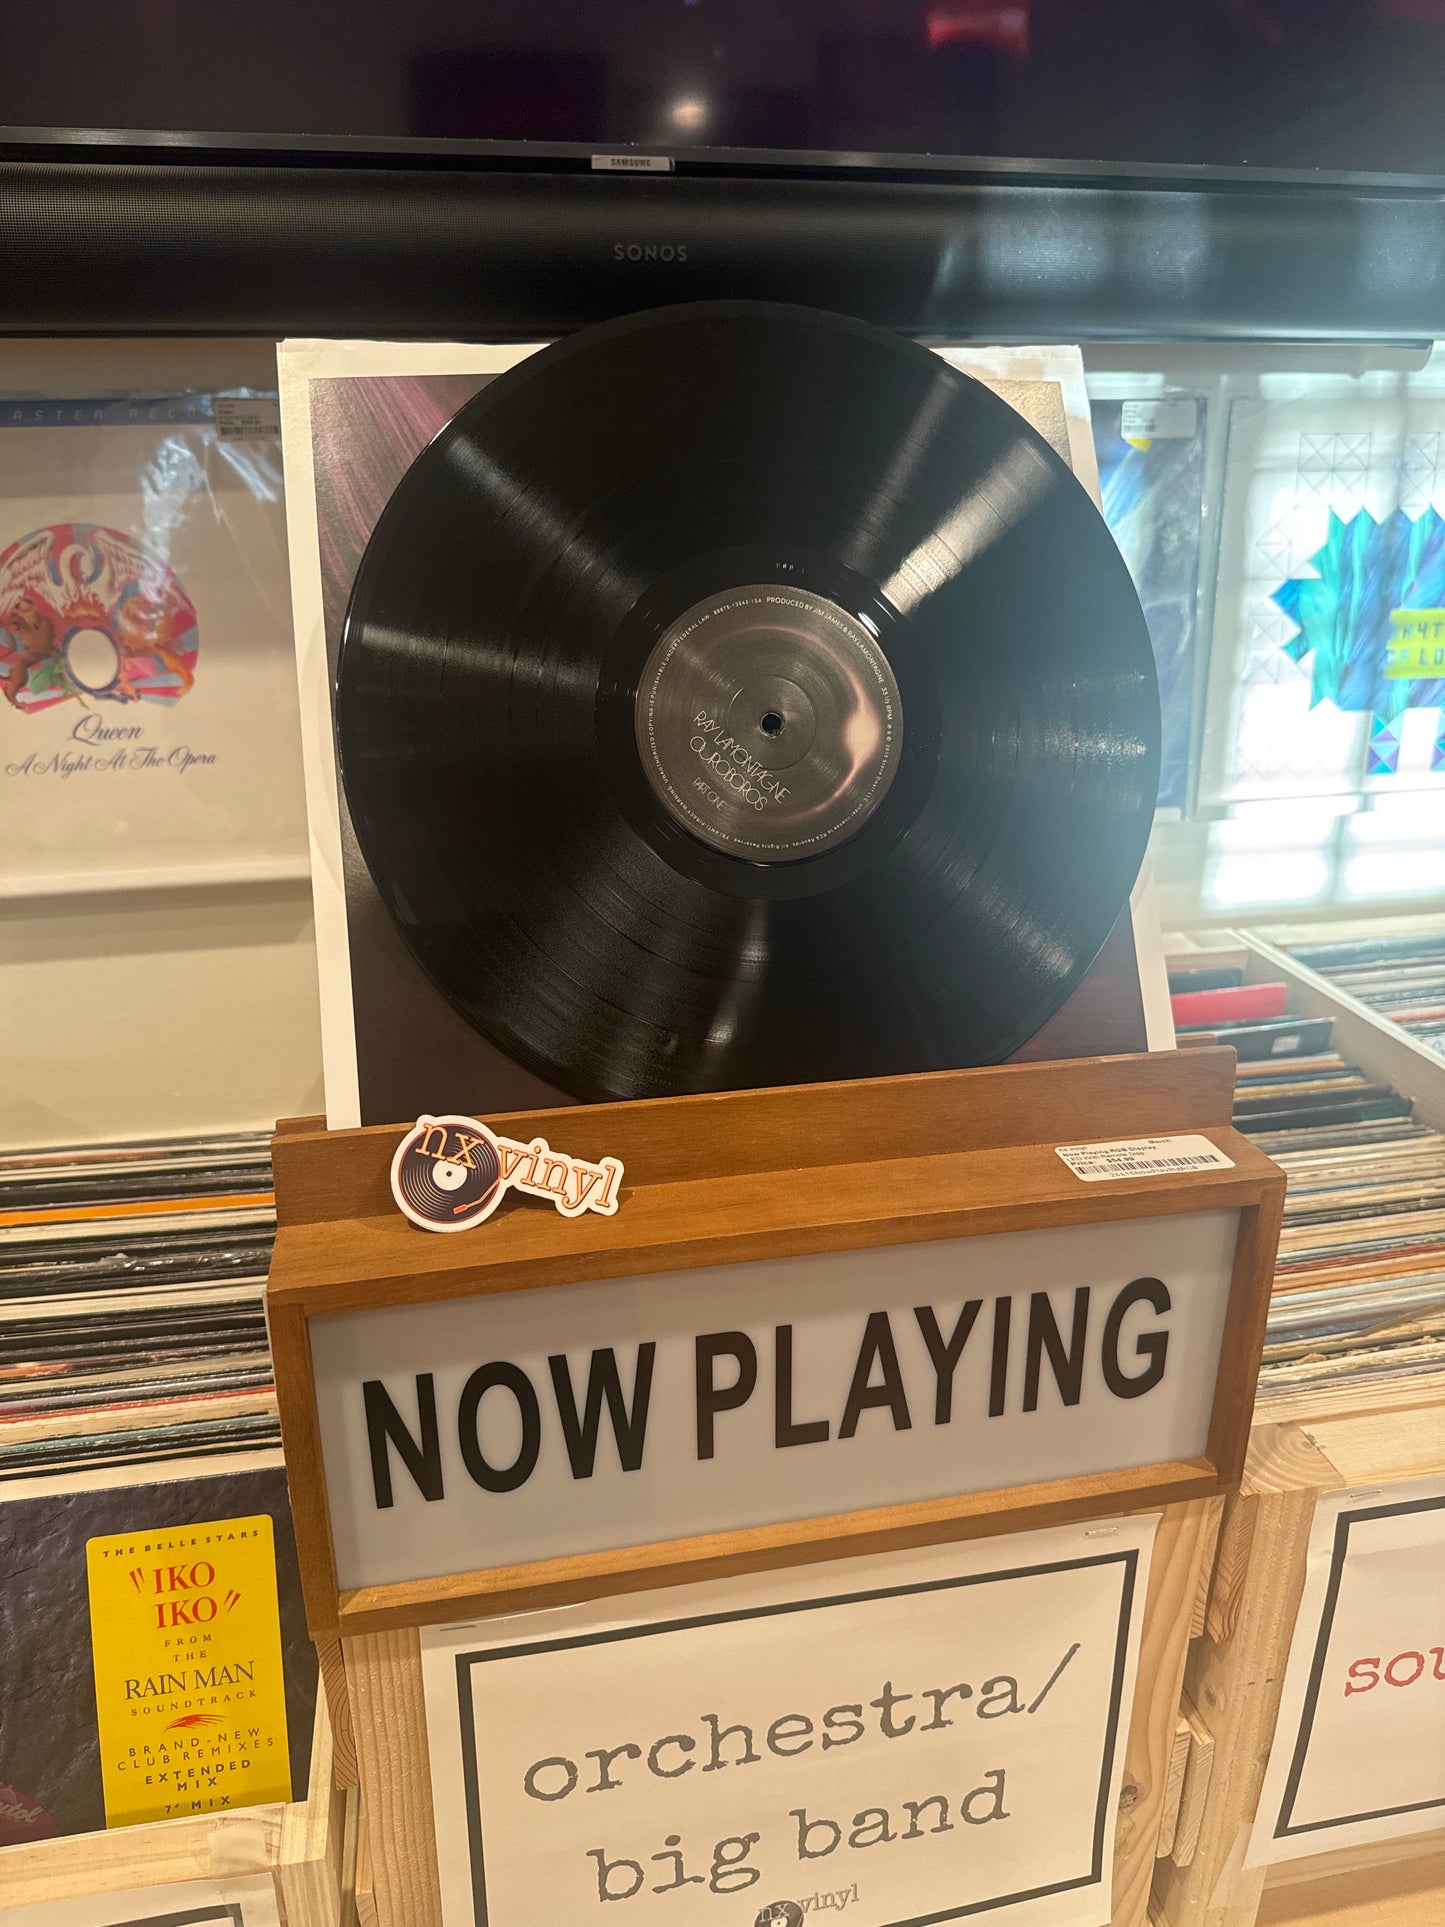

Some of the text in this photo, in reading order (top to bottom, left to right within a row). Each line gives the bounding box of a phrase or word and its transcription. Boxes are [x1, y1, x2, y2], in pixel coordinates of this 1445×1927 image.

[611, 158, 651, 167] SAMSUNG
[614, 244, 688, 262] SONOS
[676, 621, 699, 644] FEDERAL
[663, 641, 679, 662] UNDER
[766, 596, 805, 609] PRODUCED
[803, 603, 813, 612] BY
[822, 612, 844, 629] JAMES
[846, 629, 859, 643] RAY
[855, 639, 884, 683] LAMONTAGNE
[880, 686, 888, 696] 33
[884, 704, 892, 720] RPM
[649, 661, 667, 699] PUNISHABLE
[67, 713, 145, 747] Queen
[5, 746, 218, 779] A Night At The Opera
[649, 736, 669, 784] UNAUTHORIZED
[690, 736, 768, 811] OUROBOROS
[693, 710, 790, 804] RAY LAMONTAGNE
[692, 777, 728, 811] PART ONE
[415, 1122, 616, 1209] nx vinyl
[362, 1276, 1172, 1510] NOW PLAYING
[103, 1530, 259, 1558] THE BELLE STARS
[164, 1634, 212, 1647] FROM
[172, 1650, 207, 1662] THE
[125, 1661, 255, 1700] RAIN MAN
[131, 1689, 257, 1717] SOUNDTRACK
[523, 1642, 1081, 1802] orchestra/
[117, 1737, 274, 1771] CLUB REMIXES
[128, 1727, 260, 1757] BRAND-NEW
[145, 1759, 251, 1785] EXTENDED
[177, 1776, 218, 1792] MIX
[190, 1795, 231, 1810] MIX
[587, 1769, 1011, 1902] big band
[758, 1883, 860, 1922] nx vinyl
